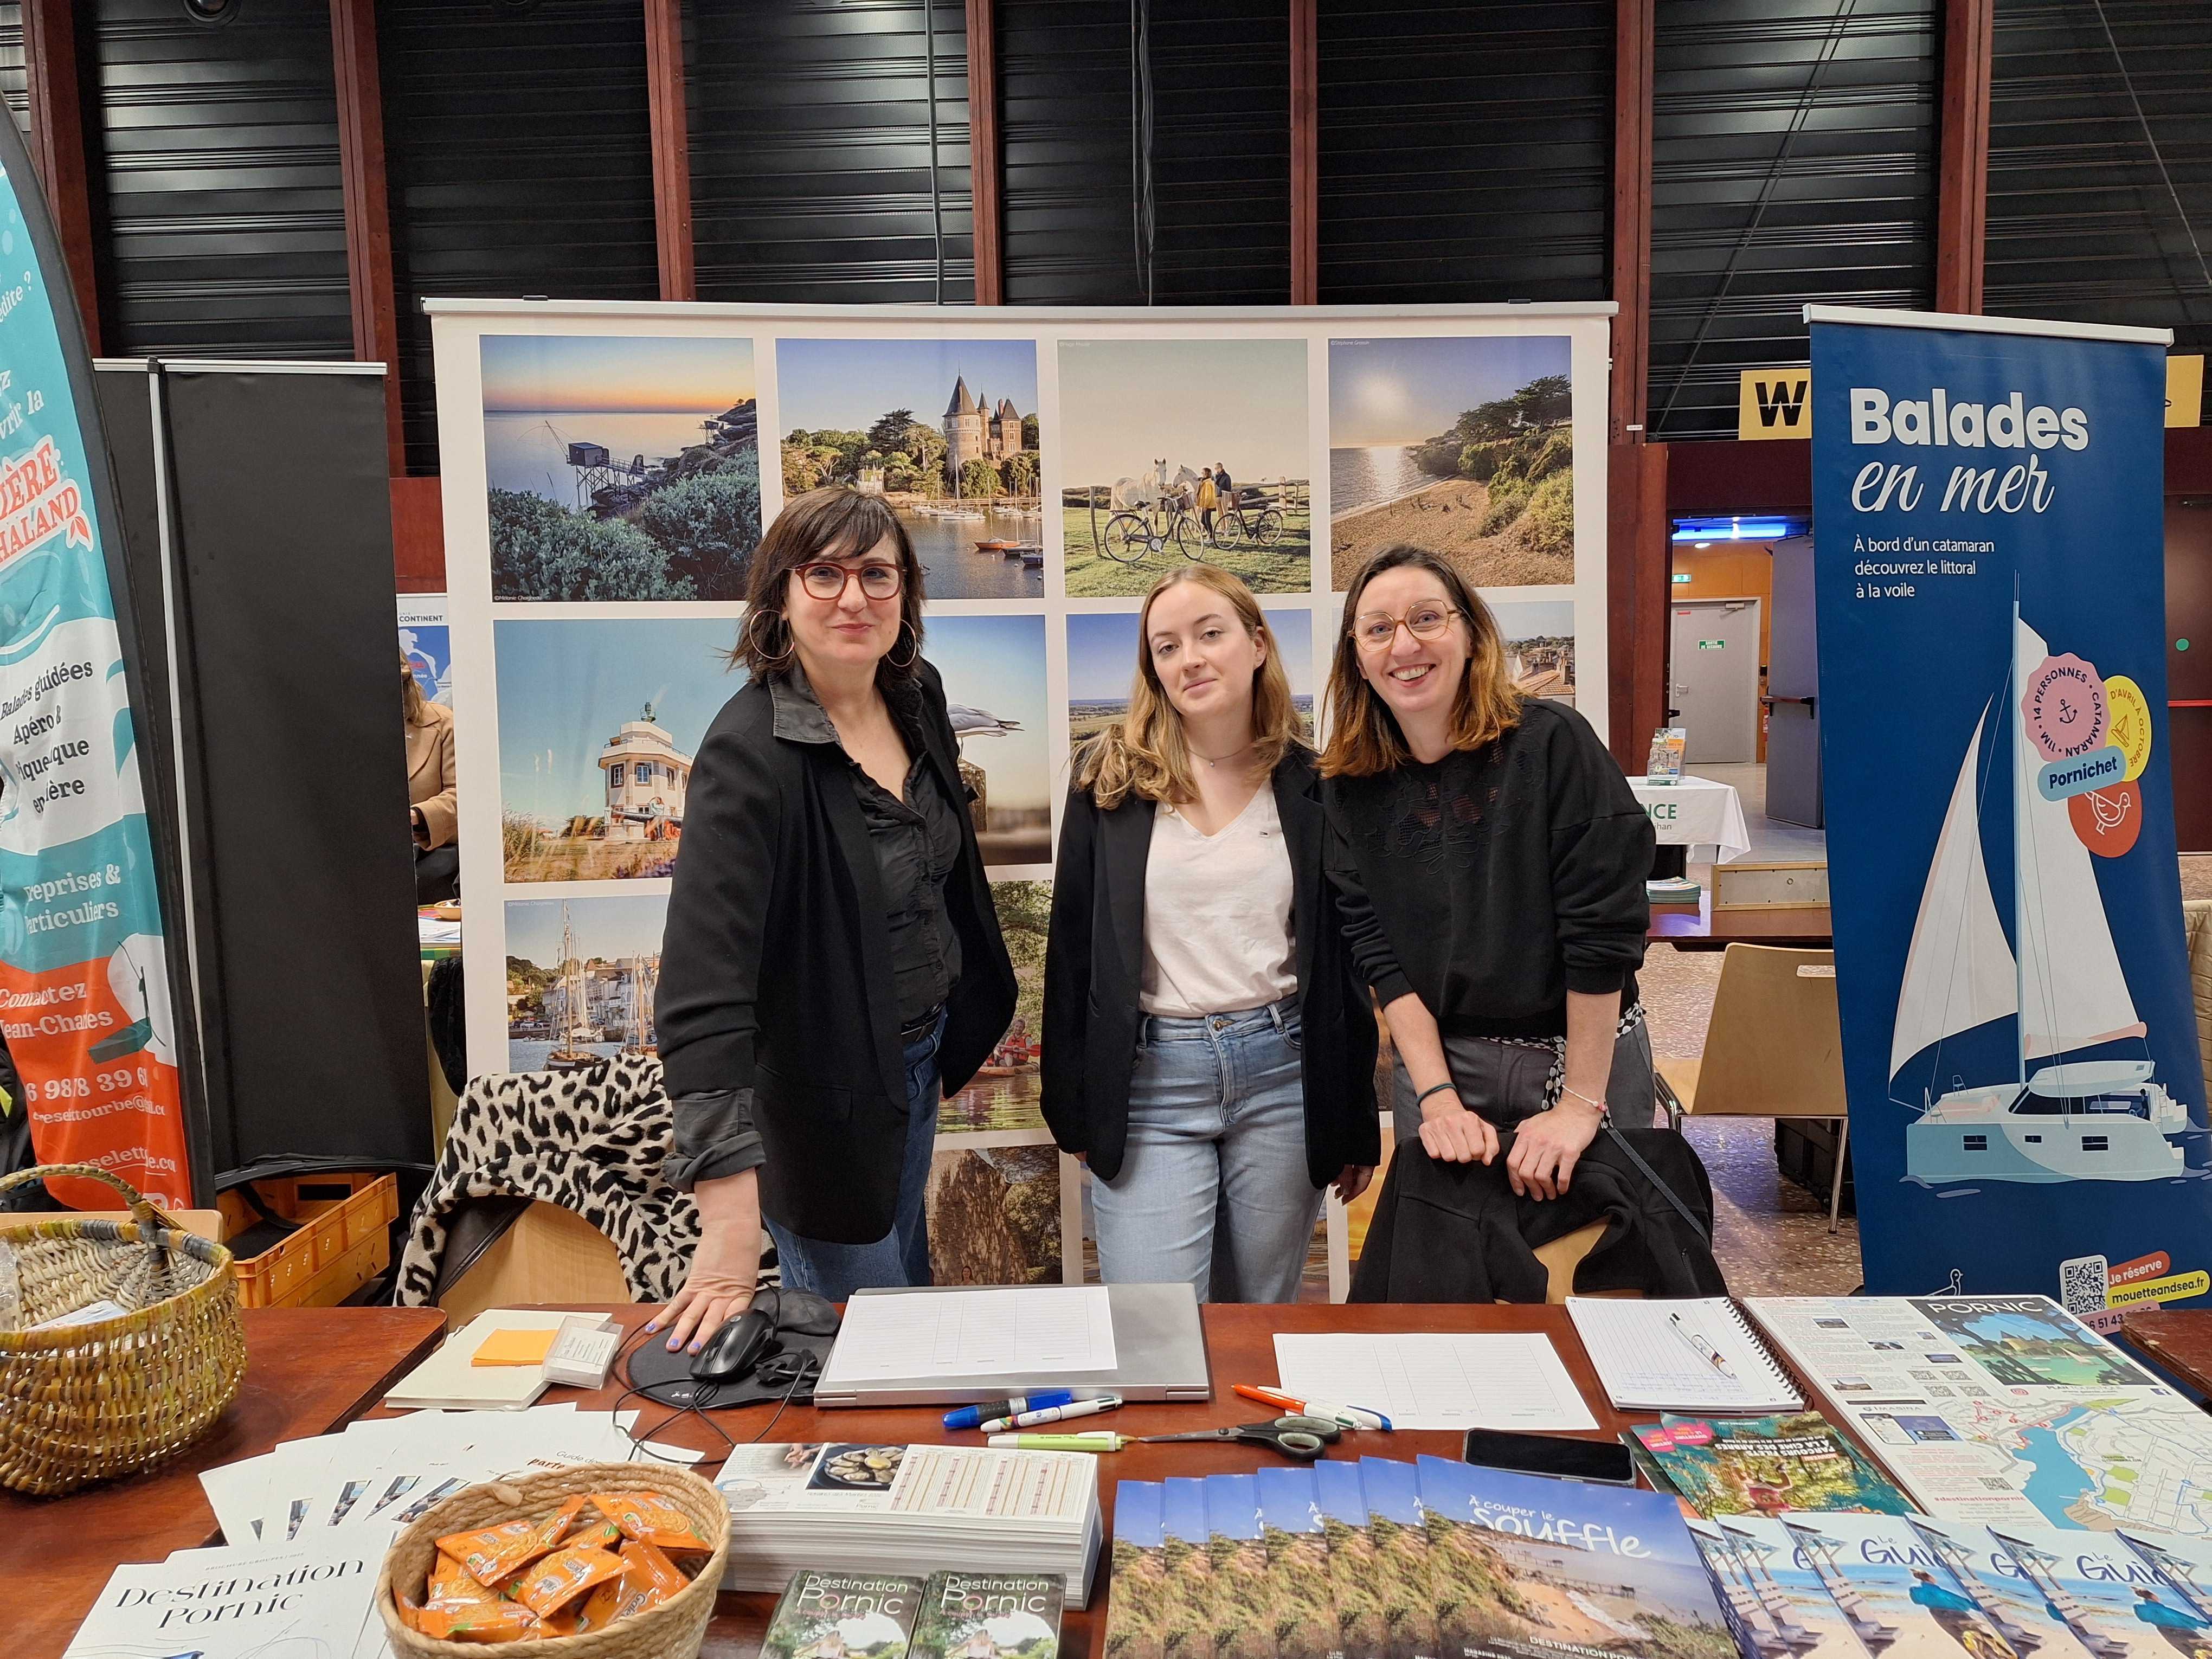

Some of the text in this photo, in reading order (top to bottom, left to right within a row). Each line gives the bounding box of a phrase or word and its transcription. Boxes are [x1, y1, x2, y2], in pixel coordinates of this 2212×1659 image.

[27, 390, 44, 415] la
[1849, 388, 2089, 451] Balades
[1850, 453, 2055, 514] en mer
[1854, 534, 1865, 552] À
[1868, 537, 1900, 552] bord
[1932, 539, 1995, 552] catamaran
[1855, 560, 1976, 575] découvrez le littoral
[1856, 582, 1915, 598] à la voile
[34, 661, 94, 702] guidées
[12, 704, 62, 744] Apéro &
[2035, 667, 2088, 704] PERSONNES
[2065, 692, 2102, 757] CATAMARAN
[2129, 718, 2145, 768] OCTOBRE
[2049, 756, 2118, 789] Pornichet
[105, 864, 121, 885] &
[96, 1069, 132, 1092] 39
[2109, 1259, 2163, 1285] Je réserve
[2112, 1277, 2205, 1304] mouetteandsea.fr
[1926, 1301, 2043, 1314] PORNIC
[2098, 1317, 2108, 1329] 51
[1780, 1446, 1836, 1457] PARCOURS
[1483, 1501, 1536, 1517] couper
[1541, 1510, 1555, 1521] le
[115, 1558, 364, 1608] Destination
[805, 1574, 908, 1593] Destination
[946, 1575, 1049, 1591] Destination
[157, 1593, 304, 1629] Pornic
[796, 1586, 904, 1615] Pornic
[941, 1587, 1047, 1613] Pornic
[1529, 1635, 1607, 1659] DESTINATION
